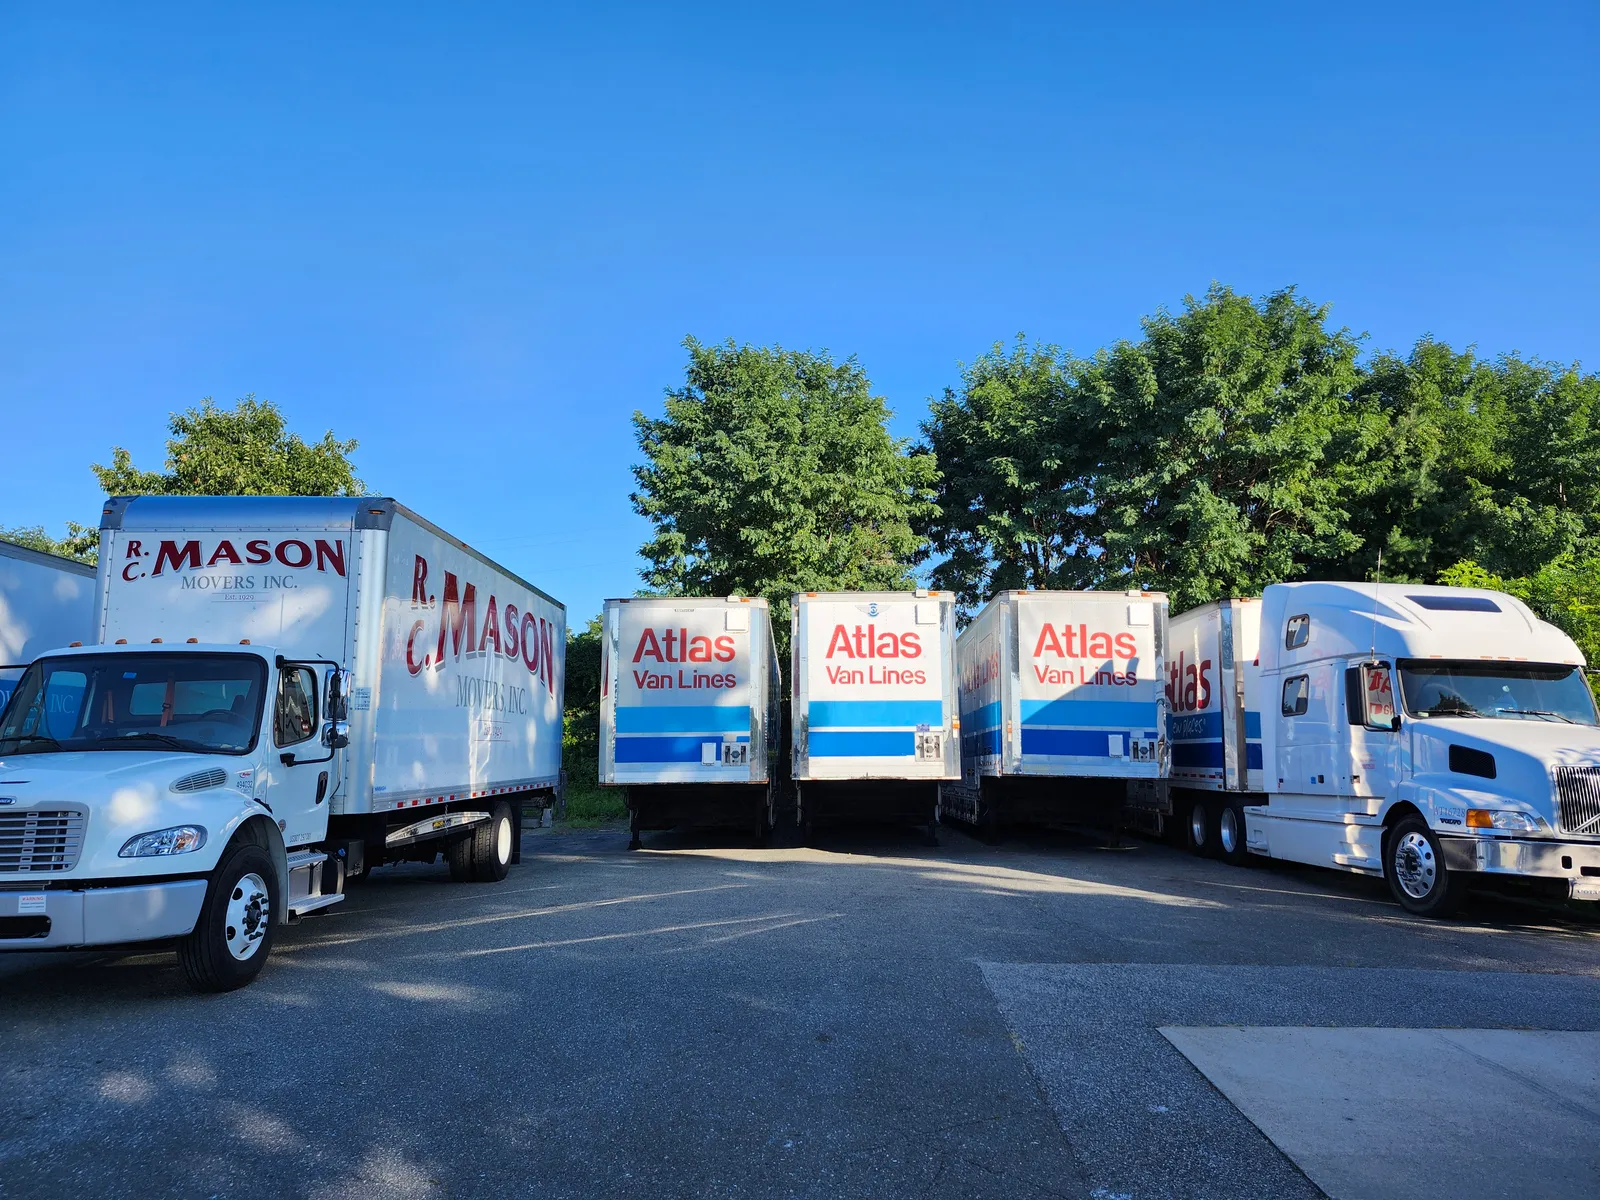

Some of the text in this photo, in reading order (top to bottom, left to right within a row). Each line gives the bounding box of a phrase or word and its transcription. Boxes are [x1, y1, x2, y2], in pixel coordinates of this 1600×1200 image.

[126, 540, 347, 577] R. MASON
[122, 562, 146, 582] C.
[181, 575, 298, 590] MOVERS INC.
[411, 554, 554, 700] R. MASON
[406, 619, 431, 677] C.
[632, 628, 736, 663] Atlas
[825, 624, 922, 658] Atlas
[1033, 623, 1137, 659] Atlas
[632, 670, 737, 689] Van Lines
[825, 665, 926, 685] Van Lines
[1033, 664, 1138, 686] Van Lines
[50, 693, 75, 713] INC.
[508, 685, 527, 715] INC.
[1439, 817, 1462, 825] VOLVO
